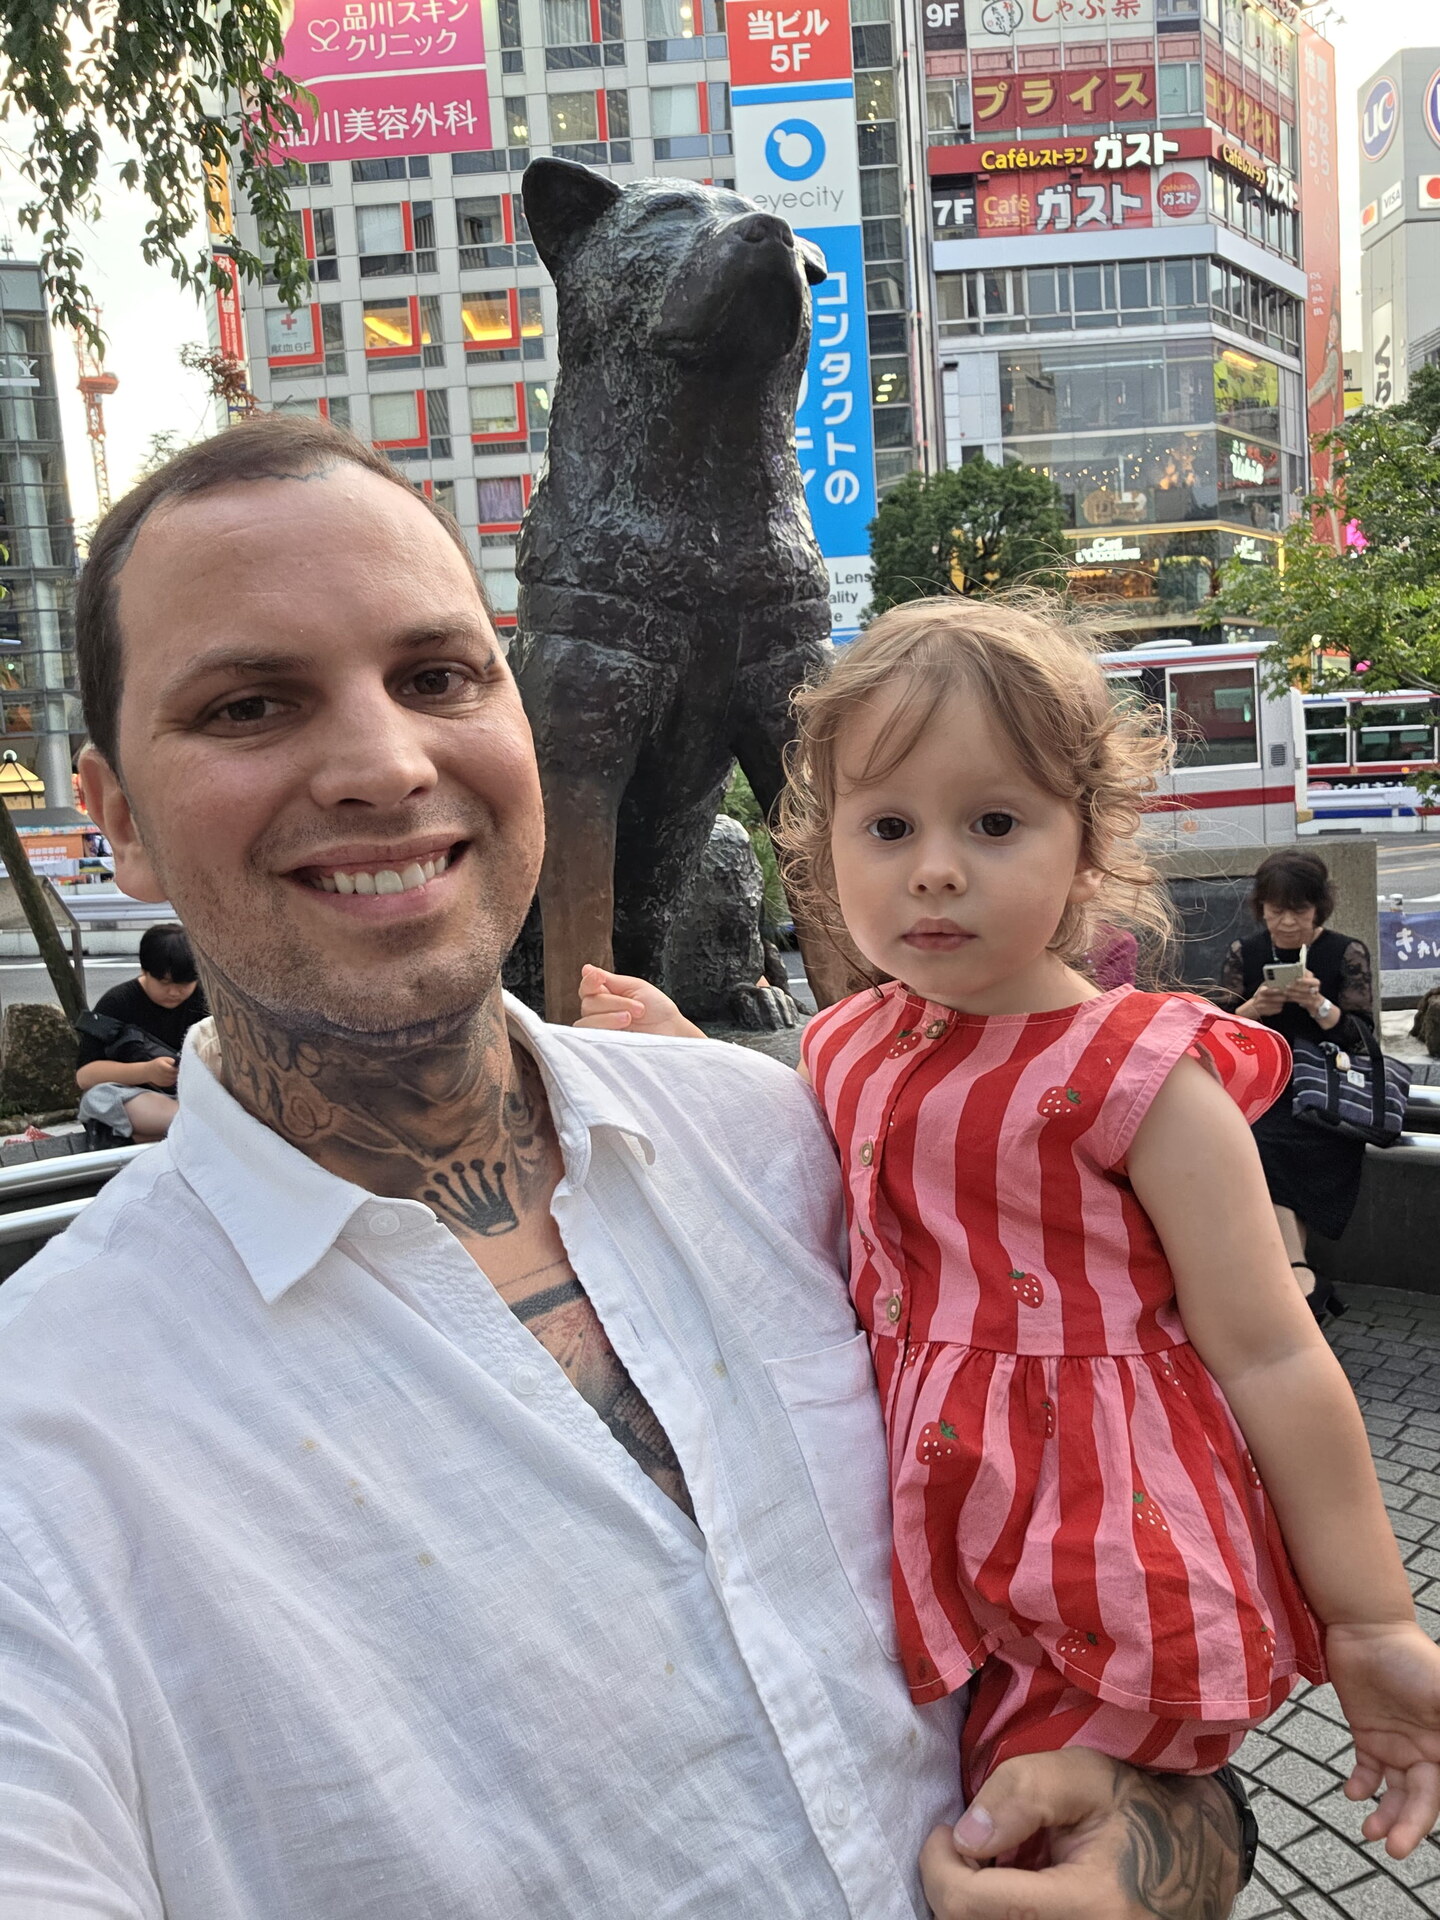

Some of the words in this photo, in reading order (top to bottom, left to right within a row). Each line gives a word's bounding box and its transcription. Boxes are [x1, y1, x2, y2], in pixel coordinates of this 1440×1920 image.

[747, 9, 830, 40] 当ビル
[926, 3, 959, 28] 9F
[346, 29, 457, 61] クリニック
[770, 43, 812, 72] 5F
[974, 72, 1153, 120] プライス
[1093, 132, 1180, 170] ガスト
[753, 186, 844, 212] eyecity
[933, 198, 974, 226] 7F
[983, 193, 1030, 216] Café
[1036, 183, 1143, 231] ガスト
[1162, 192, 1197, 206] ガスト
[1384, 189, 1401, 209] VISA
[816, 271, 861, 505] コンタクトの
[835, 572, 871, 585] Lens
[829, 590, 858, 605] ality
